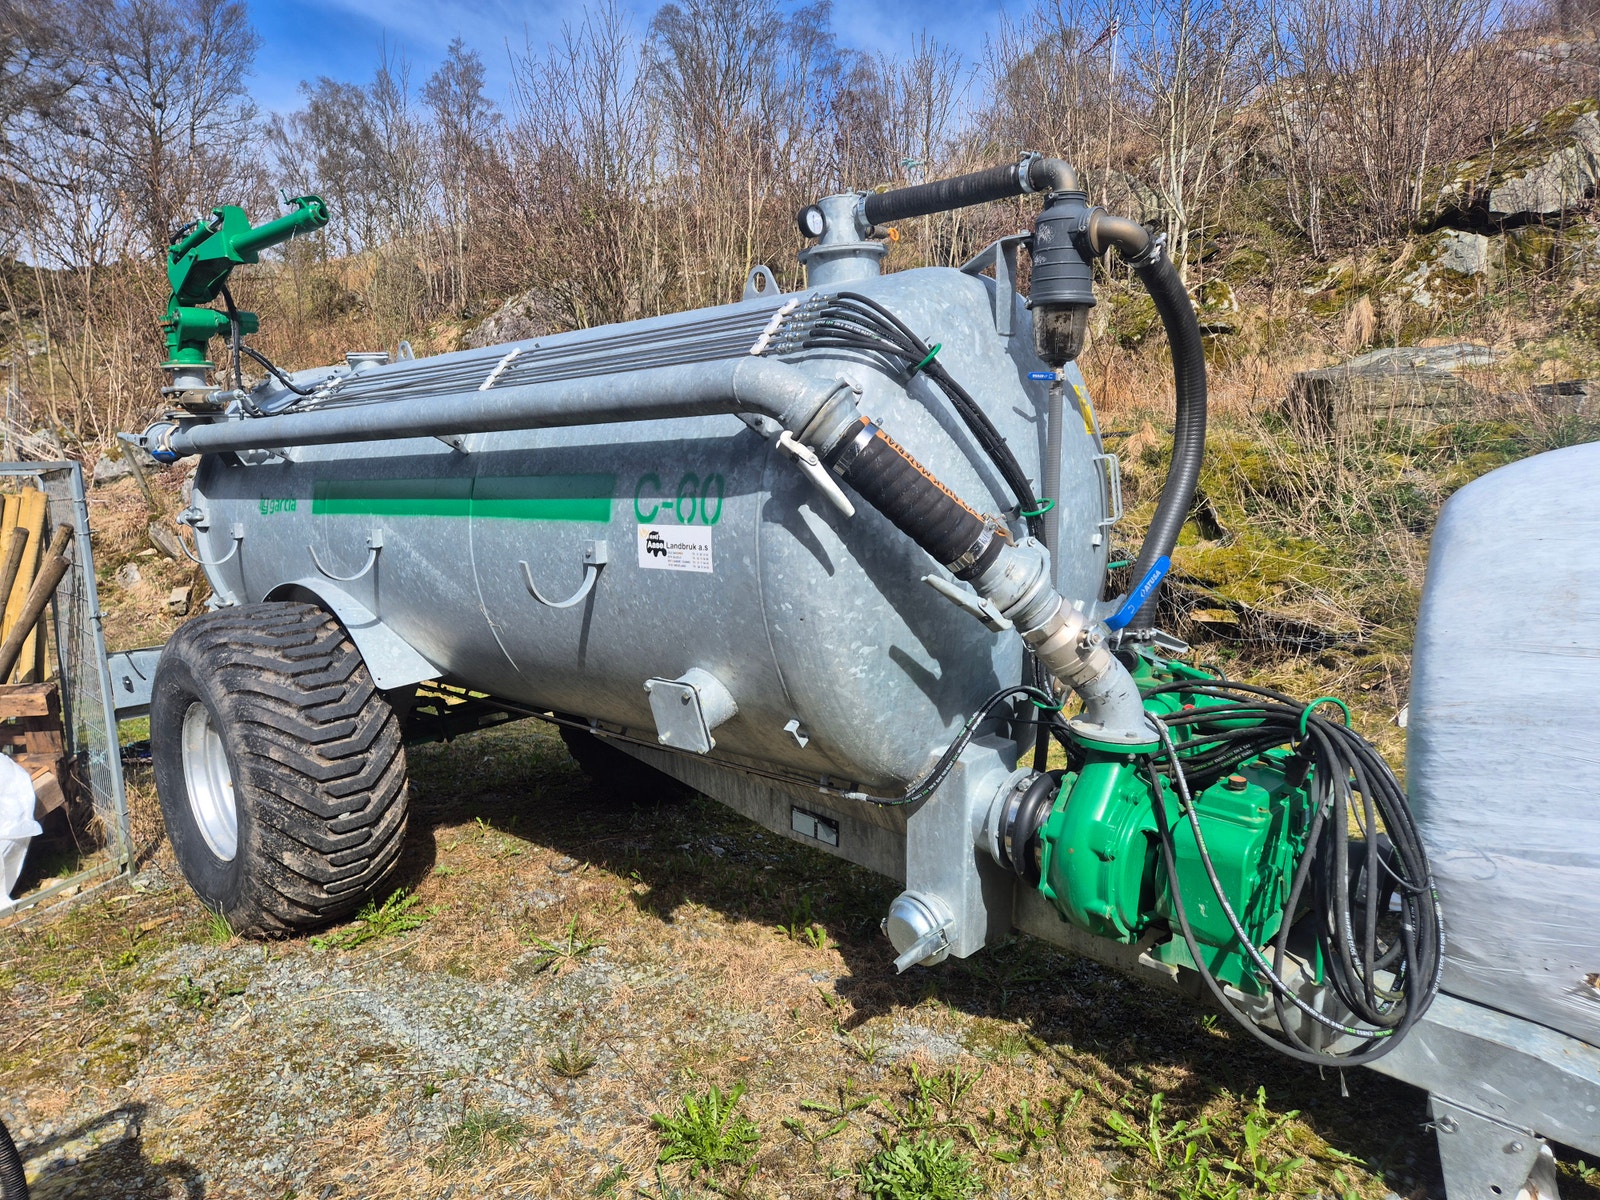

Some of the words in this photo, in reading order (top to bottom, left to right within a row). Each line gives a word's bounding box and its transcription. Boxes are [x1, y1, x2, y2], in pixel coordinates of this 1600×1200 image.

[884, 434, 931, 477] MATERIAL
[634, 472, 724, 525] C-60
[666, 542, 697, 551] Landbruk
[1144, 570, 1162, 592] ATUSA
